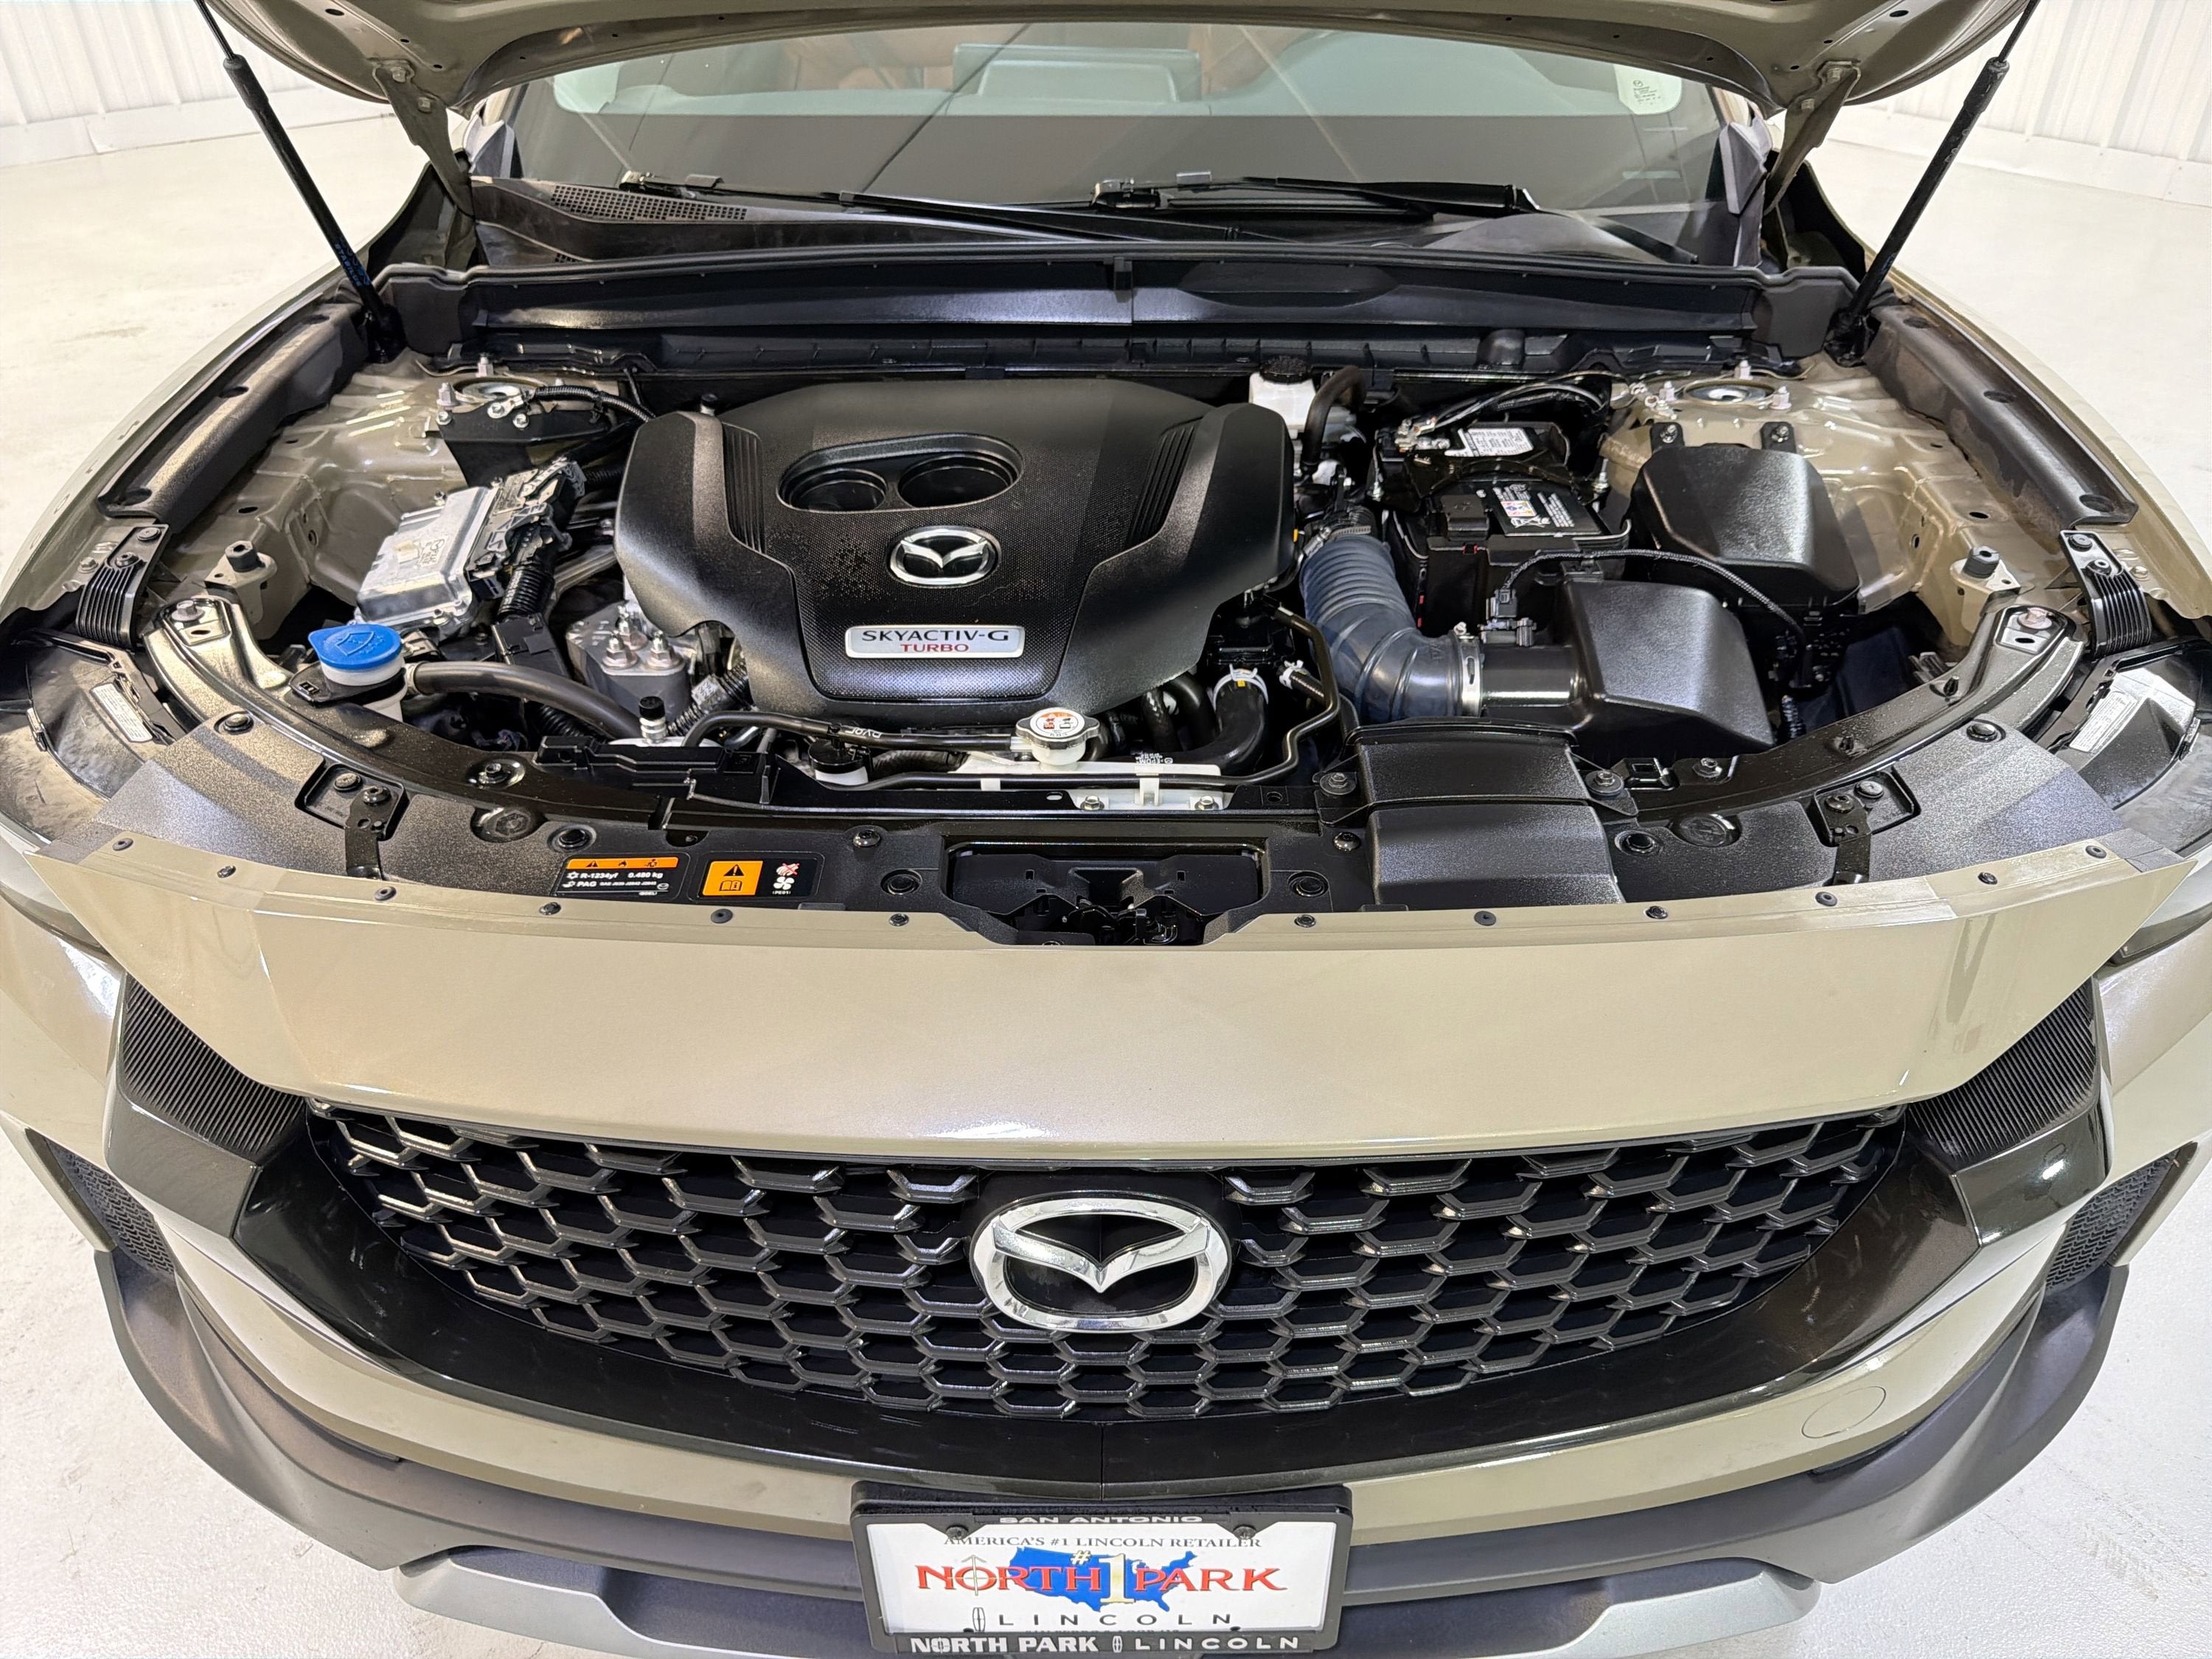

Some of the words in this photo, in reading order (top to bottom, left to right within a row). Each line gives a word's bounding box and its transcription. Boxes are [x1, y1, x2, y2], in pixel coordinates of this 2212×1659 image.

[861, 630, 1009, 641] SKYACTIV-G
[900, 643, 970, 653] TURBO
[944, 1537, 1045, 1546] AMERICA'S
[1050, 1537, 1068, 1546] #1
[1077, 1537, 1164, 1547] LINCOLN
[1170, 1538, 1263, 1548] RETAILER
[915, 1565, 1102, 1592] NORTH
[1134, 1568, 1289, 1592] PARK
[998, 1613, 1231, 1626] LINCOLN
[910, 1637, 1007, 1653] NORTH
[1018, 1636, 1099, 1652] PARK
[1135, 1637, 1298, 1650] LINCOLN
